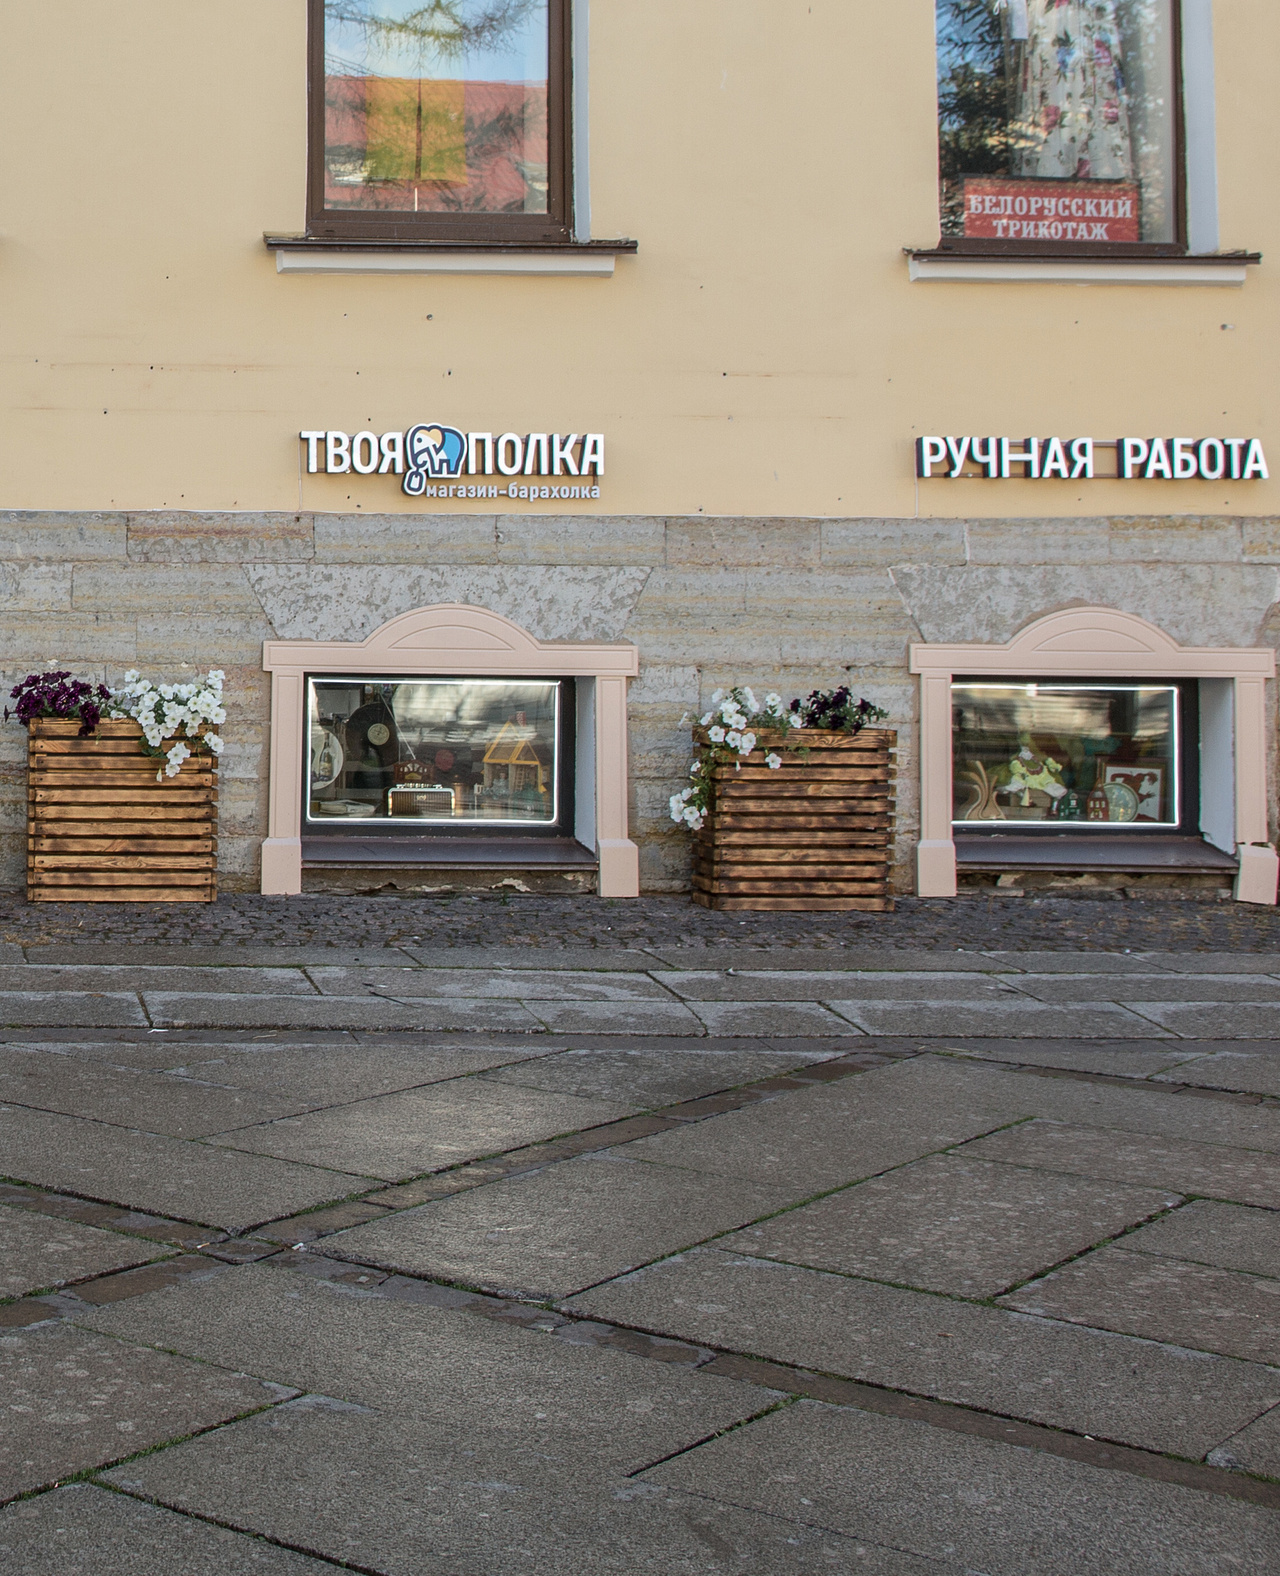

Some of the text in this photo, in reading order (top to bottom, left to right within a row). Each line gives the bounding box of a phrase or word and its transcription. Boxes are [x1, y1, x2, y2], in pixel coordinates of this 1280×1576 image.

[969, 195, 1133, 218] БЕЛОРУССКИЙ
[992, 220, 1109, 240] ТРИКОТАЖ
[300, 430, 605, 476] ТВОЯ ПОЛКА
[920, 436, 1270, 480] РУЧНАЯ РАБОТА
[425, 481, 601, 502] магазин-барахолка
